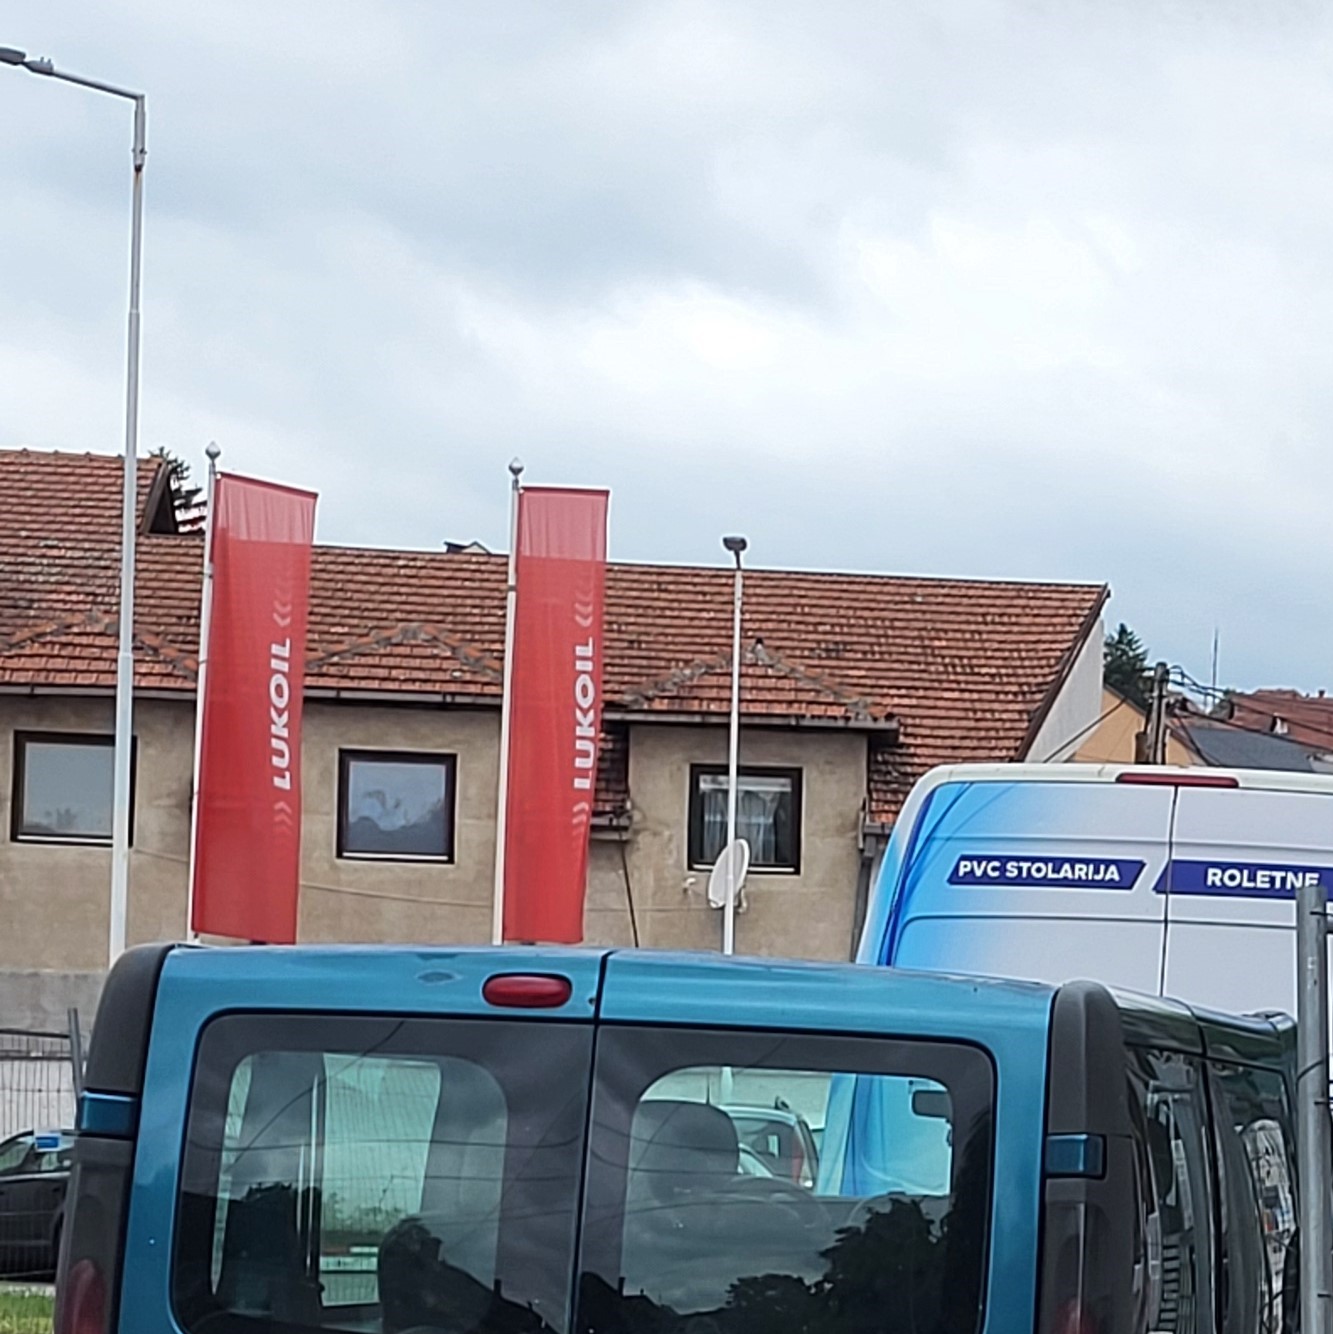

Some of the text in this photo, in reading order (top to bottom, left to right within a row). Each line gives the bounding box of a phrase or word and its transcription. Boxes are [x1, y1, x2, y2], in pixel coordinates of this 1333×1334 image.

[270, 637, 293, 791] LUKOIL
[573, 636, 595, 789] LUKOIL
[958, 860, 1121, 882] PVC STOLARIJA
